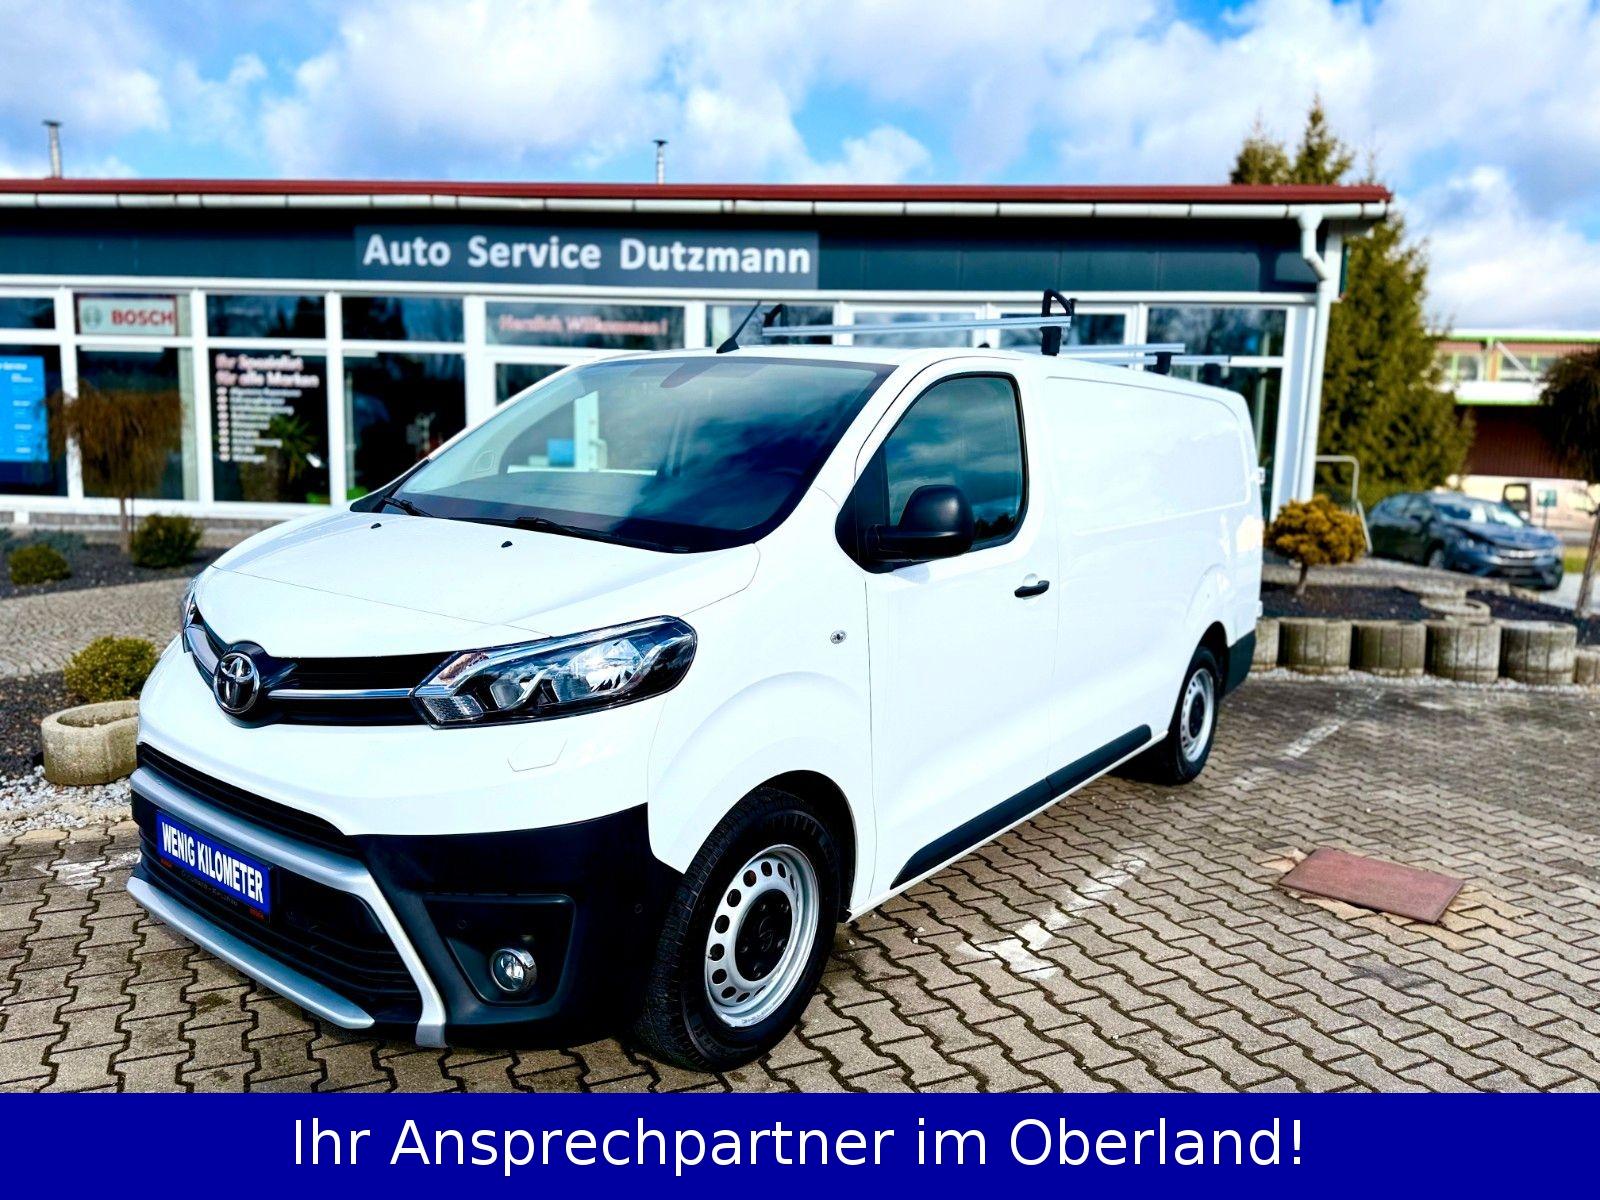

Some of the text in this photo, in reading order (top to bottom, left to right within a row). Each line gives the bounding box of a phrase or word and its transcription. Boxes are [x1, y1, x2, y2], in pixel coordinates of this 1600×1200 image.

[363, 234, 811, 275] Auto Service Dutzmann
[111, 309, 175, 325] BOSCH
[162, 822, 196, 867] WENIG
[197, 841, 264, 904] KILOMETER
